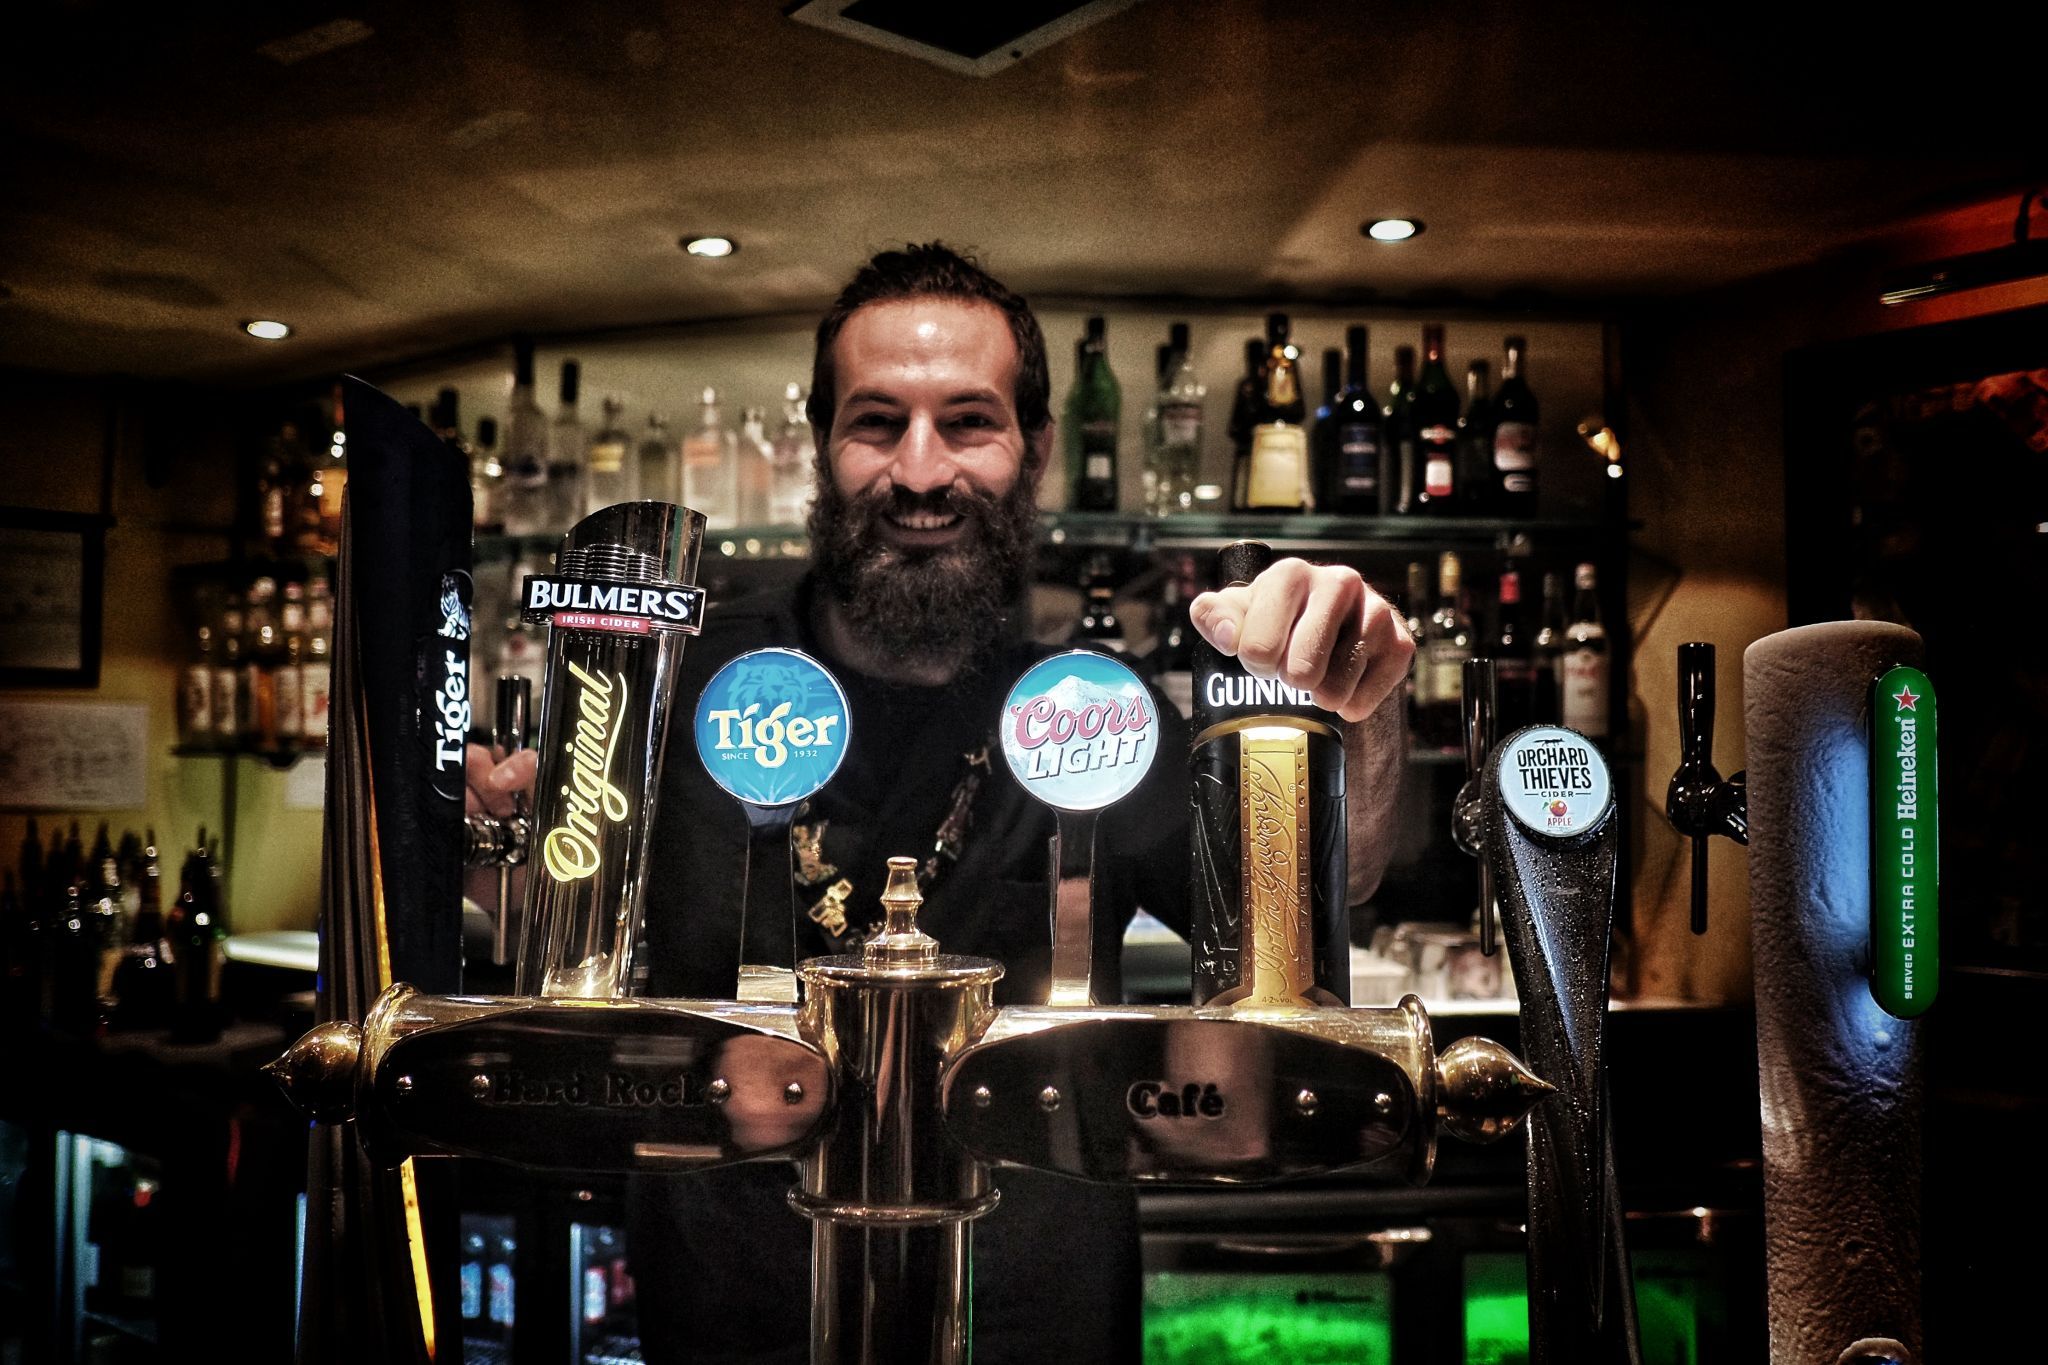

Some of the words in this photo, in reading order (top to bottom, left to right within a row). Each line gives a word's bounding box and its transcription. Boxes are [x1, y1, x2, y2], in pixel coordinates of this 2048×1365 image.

[529, 580, 690, 620] BULMERS
[562, 615, 596, 626] IRISH
[600, 617, 640, 629] CIDER
[1206, 672, 1314, 707] GUINNE
[434, 650, 470, 772] Tiger
[1011, 693, 1152, 749] Coors
[708, 701, 839, 769] Tiger
[793, 750, 818, 759] 1932
[543, 660, 628, 883] Original
[721, 752, 749, 761] SINCE
[1026, 733, 1147, 780] LIGHT
[1516, 747, 1589, 767] ORCHARD
[1897, 718, 1917, 820] Heineken
[1297, 746, 1306, 809] GATE
[1519, 767, 1592, 790] THIEVES
[1540, 790, 1574, 798] CIDER
[1547, 817, 1573, 827] APPLE
[1902, 827, 1915, 878] COLD
[1902, 885, 1915, 948] EXTRA
[1904, 953, 1913, 999] SERVED
[490, 1070, 590, 1107] Hard
[1127, 1081, 1226, 1121] Café
